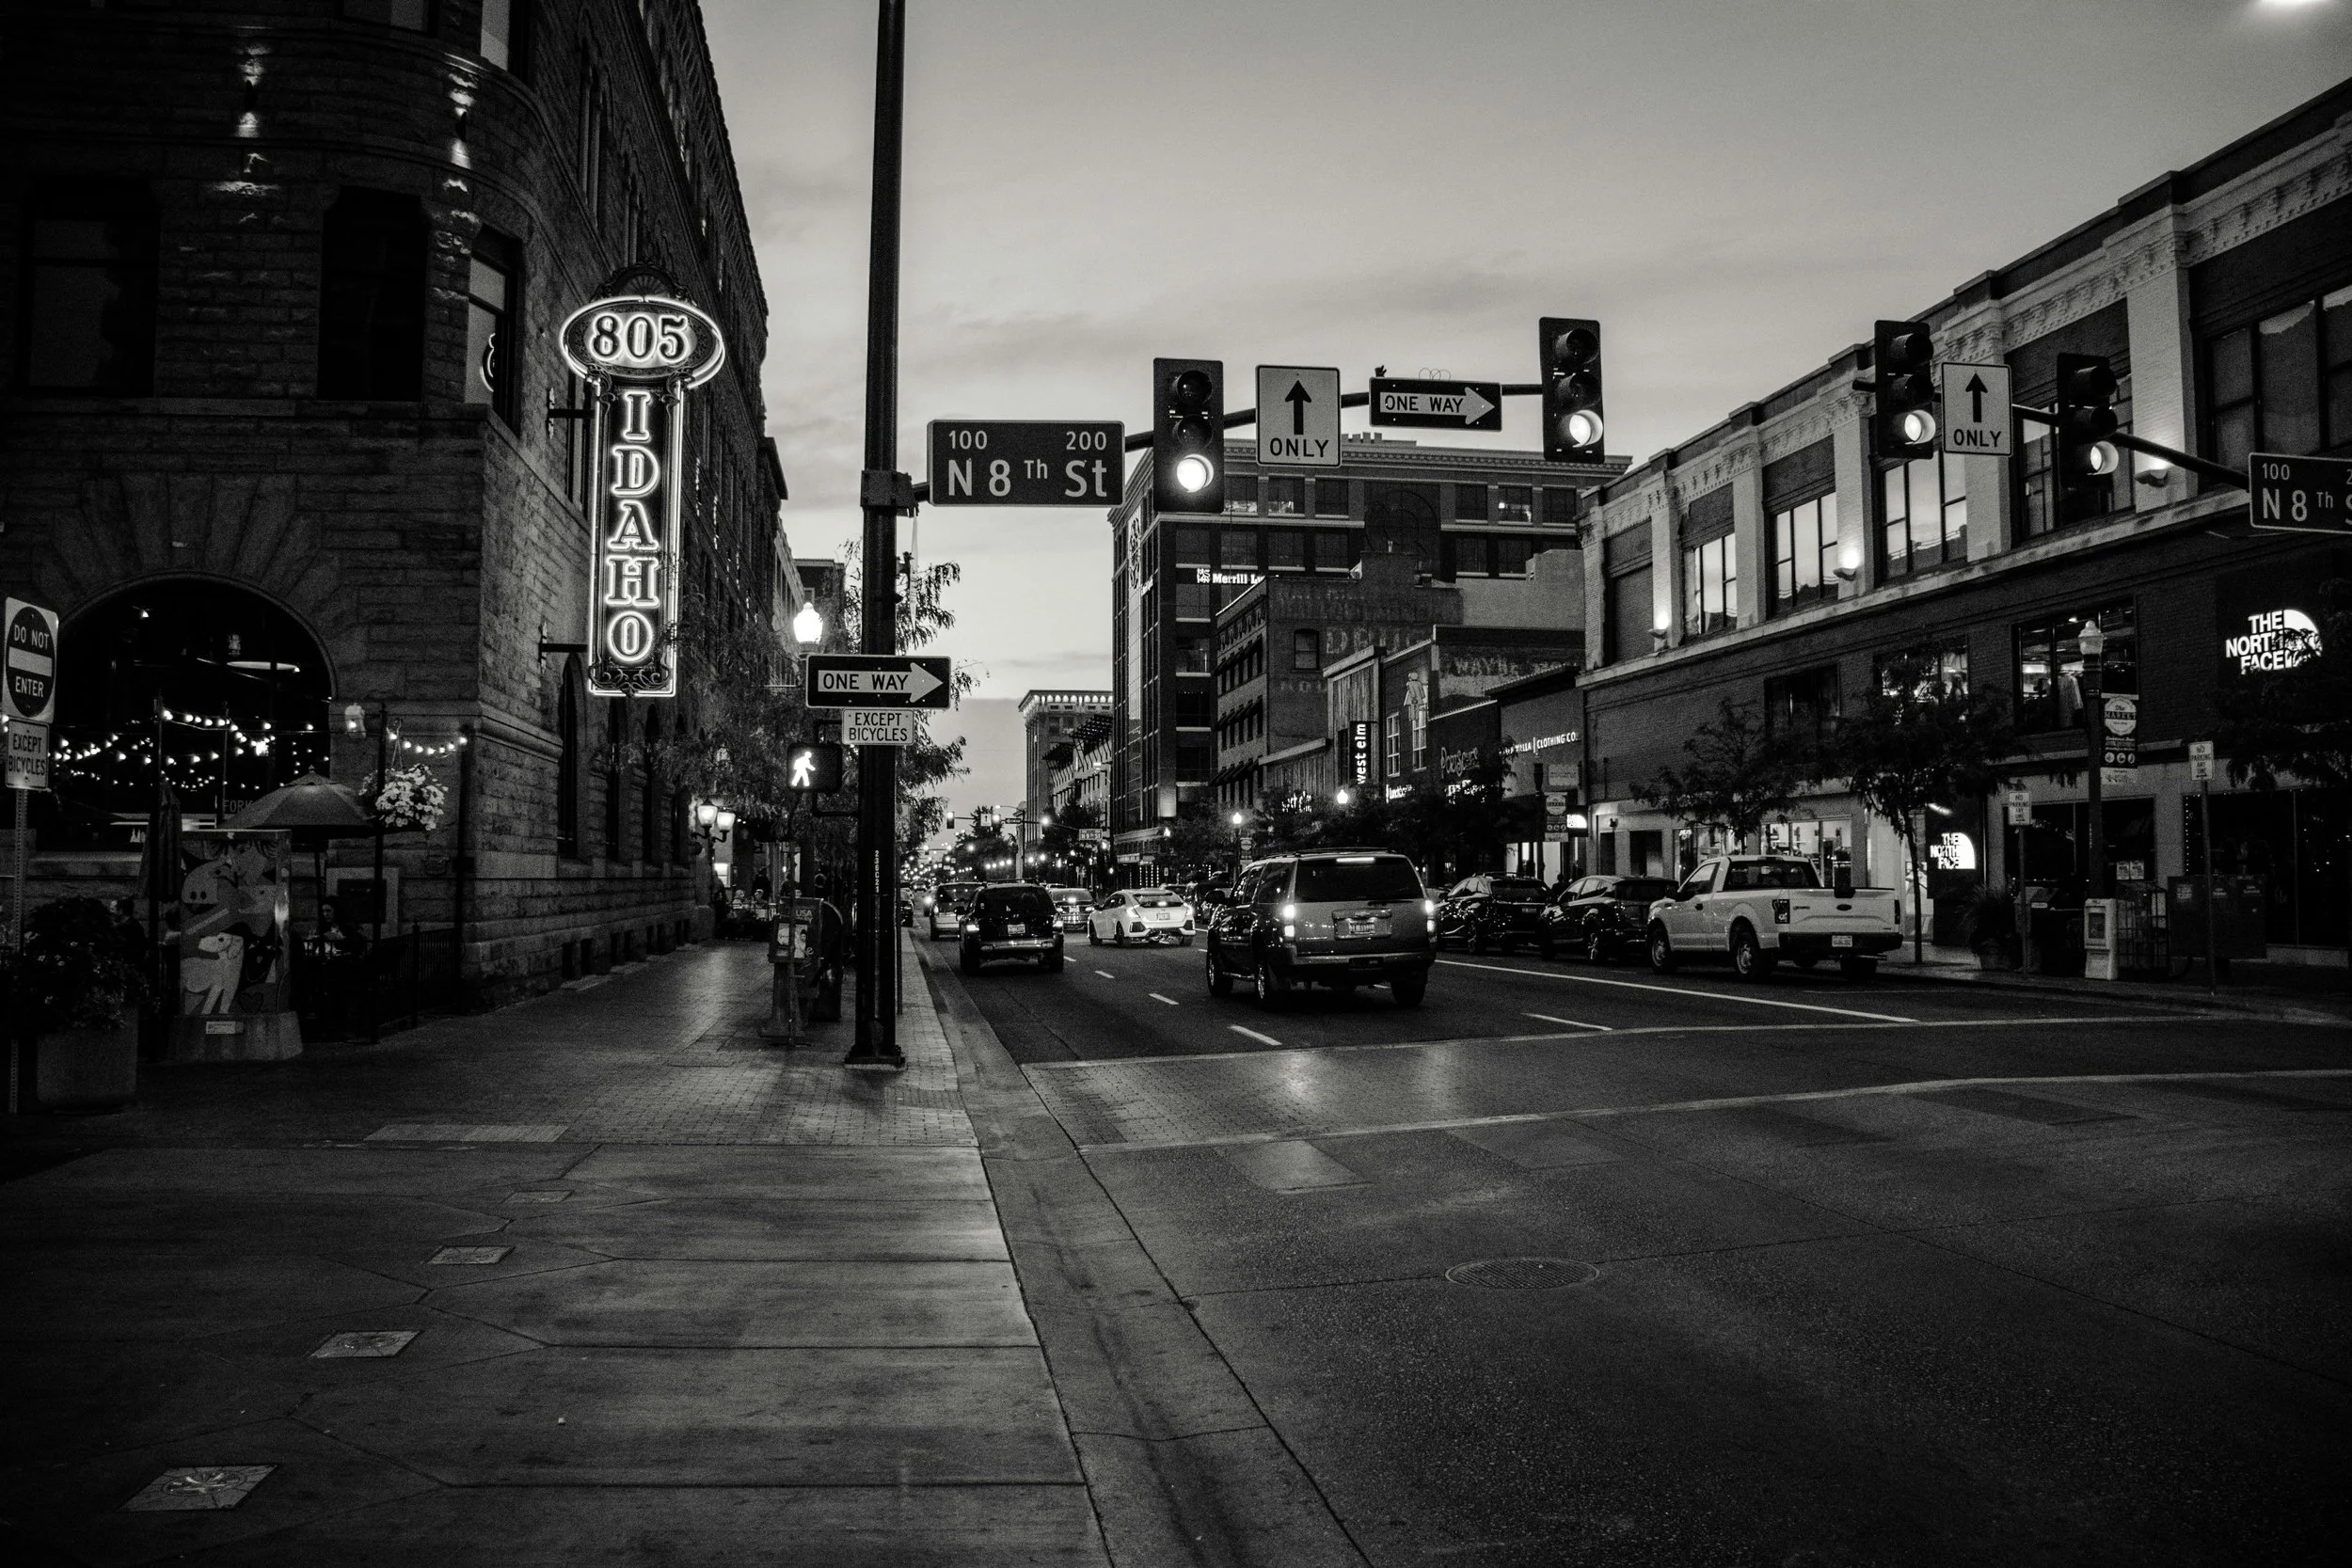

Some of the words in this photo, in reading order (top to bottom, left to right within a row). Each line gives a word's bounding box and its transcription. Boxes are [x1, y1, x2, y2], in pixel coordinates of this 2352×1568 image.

[589, 312, 689, 364] 805
[1385, 394, 1419, 411] ONE
[1430, 396, 1464, 413] WAY
[948, 430, 988, 450] 100
[1065, 431, 1107, 451] 200
[1269, 437, 1329, 458] ONLY
[1953, 428, 2002, 448] ONLY
[947, 459, 973, 497] N
[1064, 459, 1107, 498] St
[2261, 462, 2291, 481] 100
[2263, 487, 2280, 520] N
[605, 390, 660, 664] IDAHO
[1212, 573, 1248, 585] Merrill
[2247, 610, 2284, 634] THE
[13, 624, 27, 643] DO
[31, 629, 50, 650] NOT
[2240, 649, 2285, 675] FACE
[14, 675, 44, 699] ENTER
[822, 673, 860, 690] ONE
[871, 673, 909, 690] WAY
[854, 712, 902, 726] EXCEPT
[12, 733, 43, 752] EXCEPT
[849, 727, 908, 742] BICYCLES
[1355, 723, 1367, 749] elm
[1536, 734, 1565, 750] CLOTHING
[8, 754, 46, 776] BICYCLES
[1355, 752, 1367, 784] west
